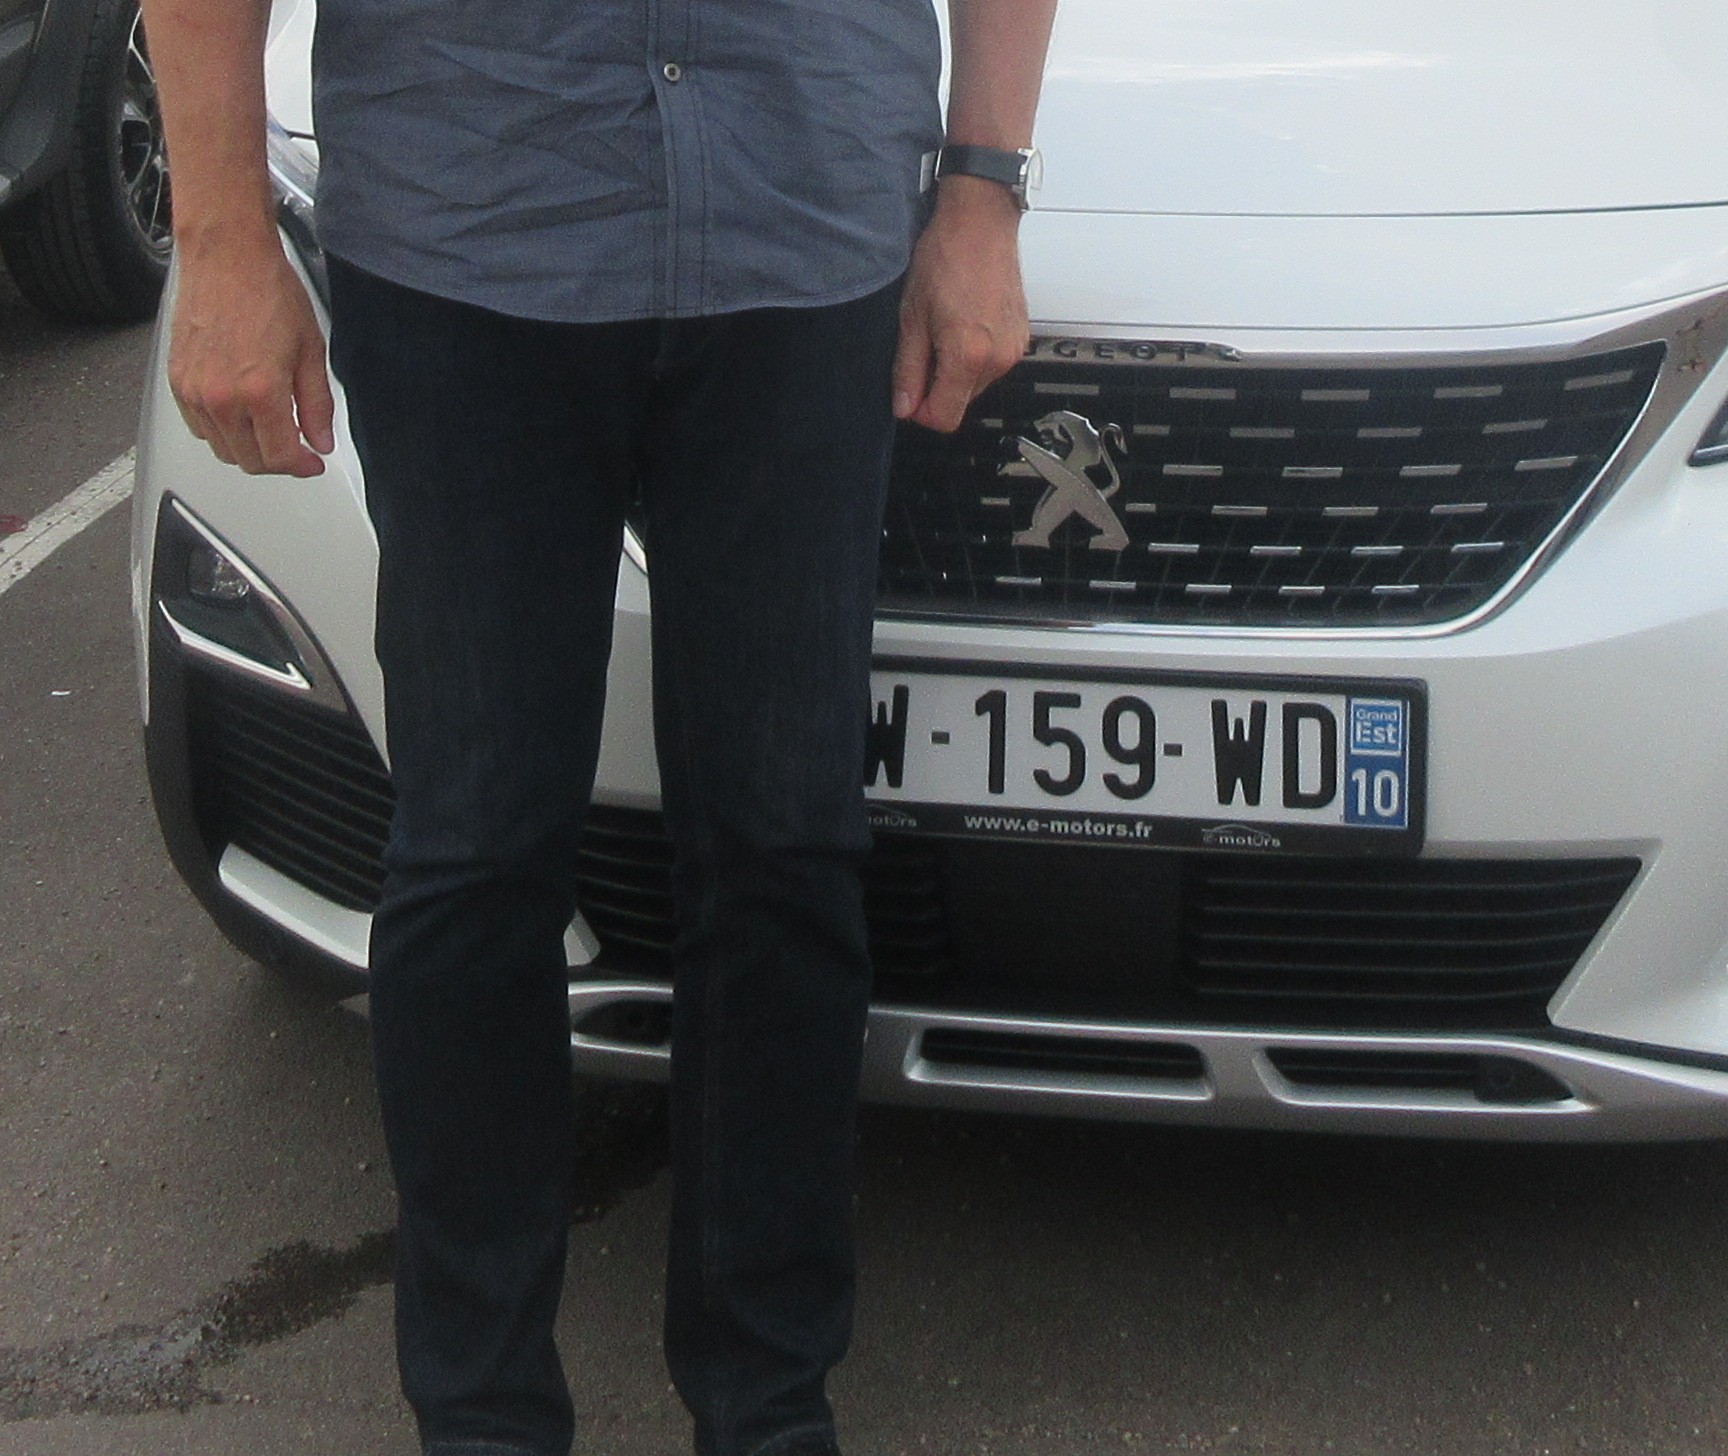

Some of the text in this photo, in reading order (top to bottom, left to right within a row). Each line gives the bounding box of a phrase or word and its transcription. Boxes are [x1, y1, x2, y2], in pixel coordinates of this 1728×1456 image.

[1356, 708, 1398, 721] Grand
[1355, 720, 1397, 744] Est
[1352, 768, 1399, 817] 10
[964, 813, 1154, 838] www.e-motors.fr
